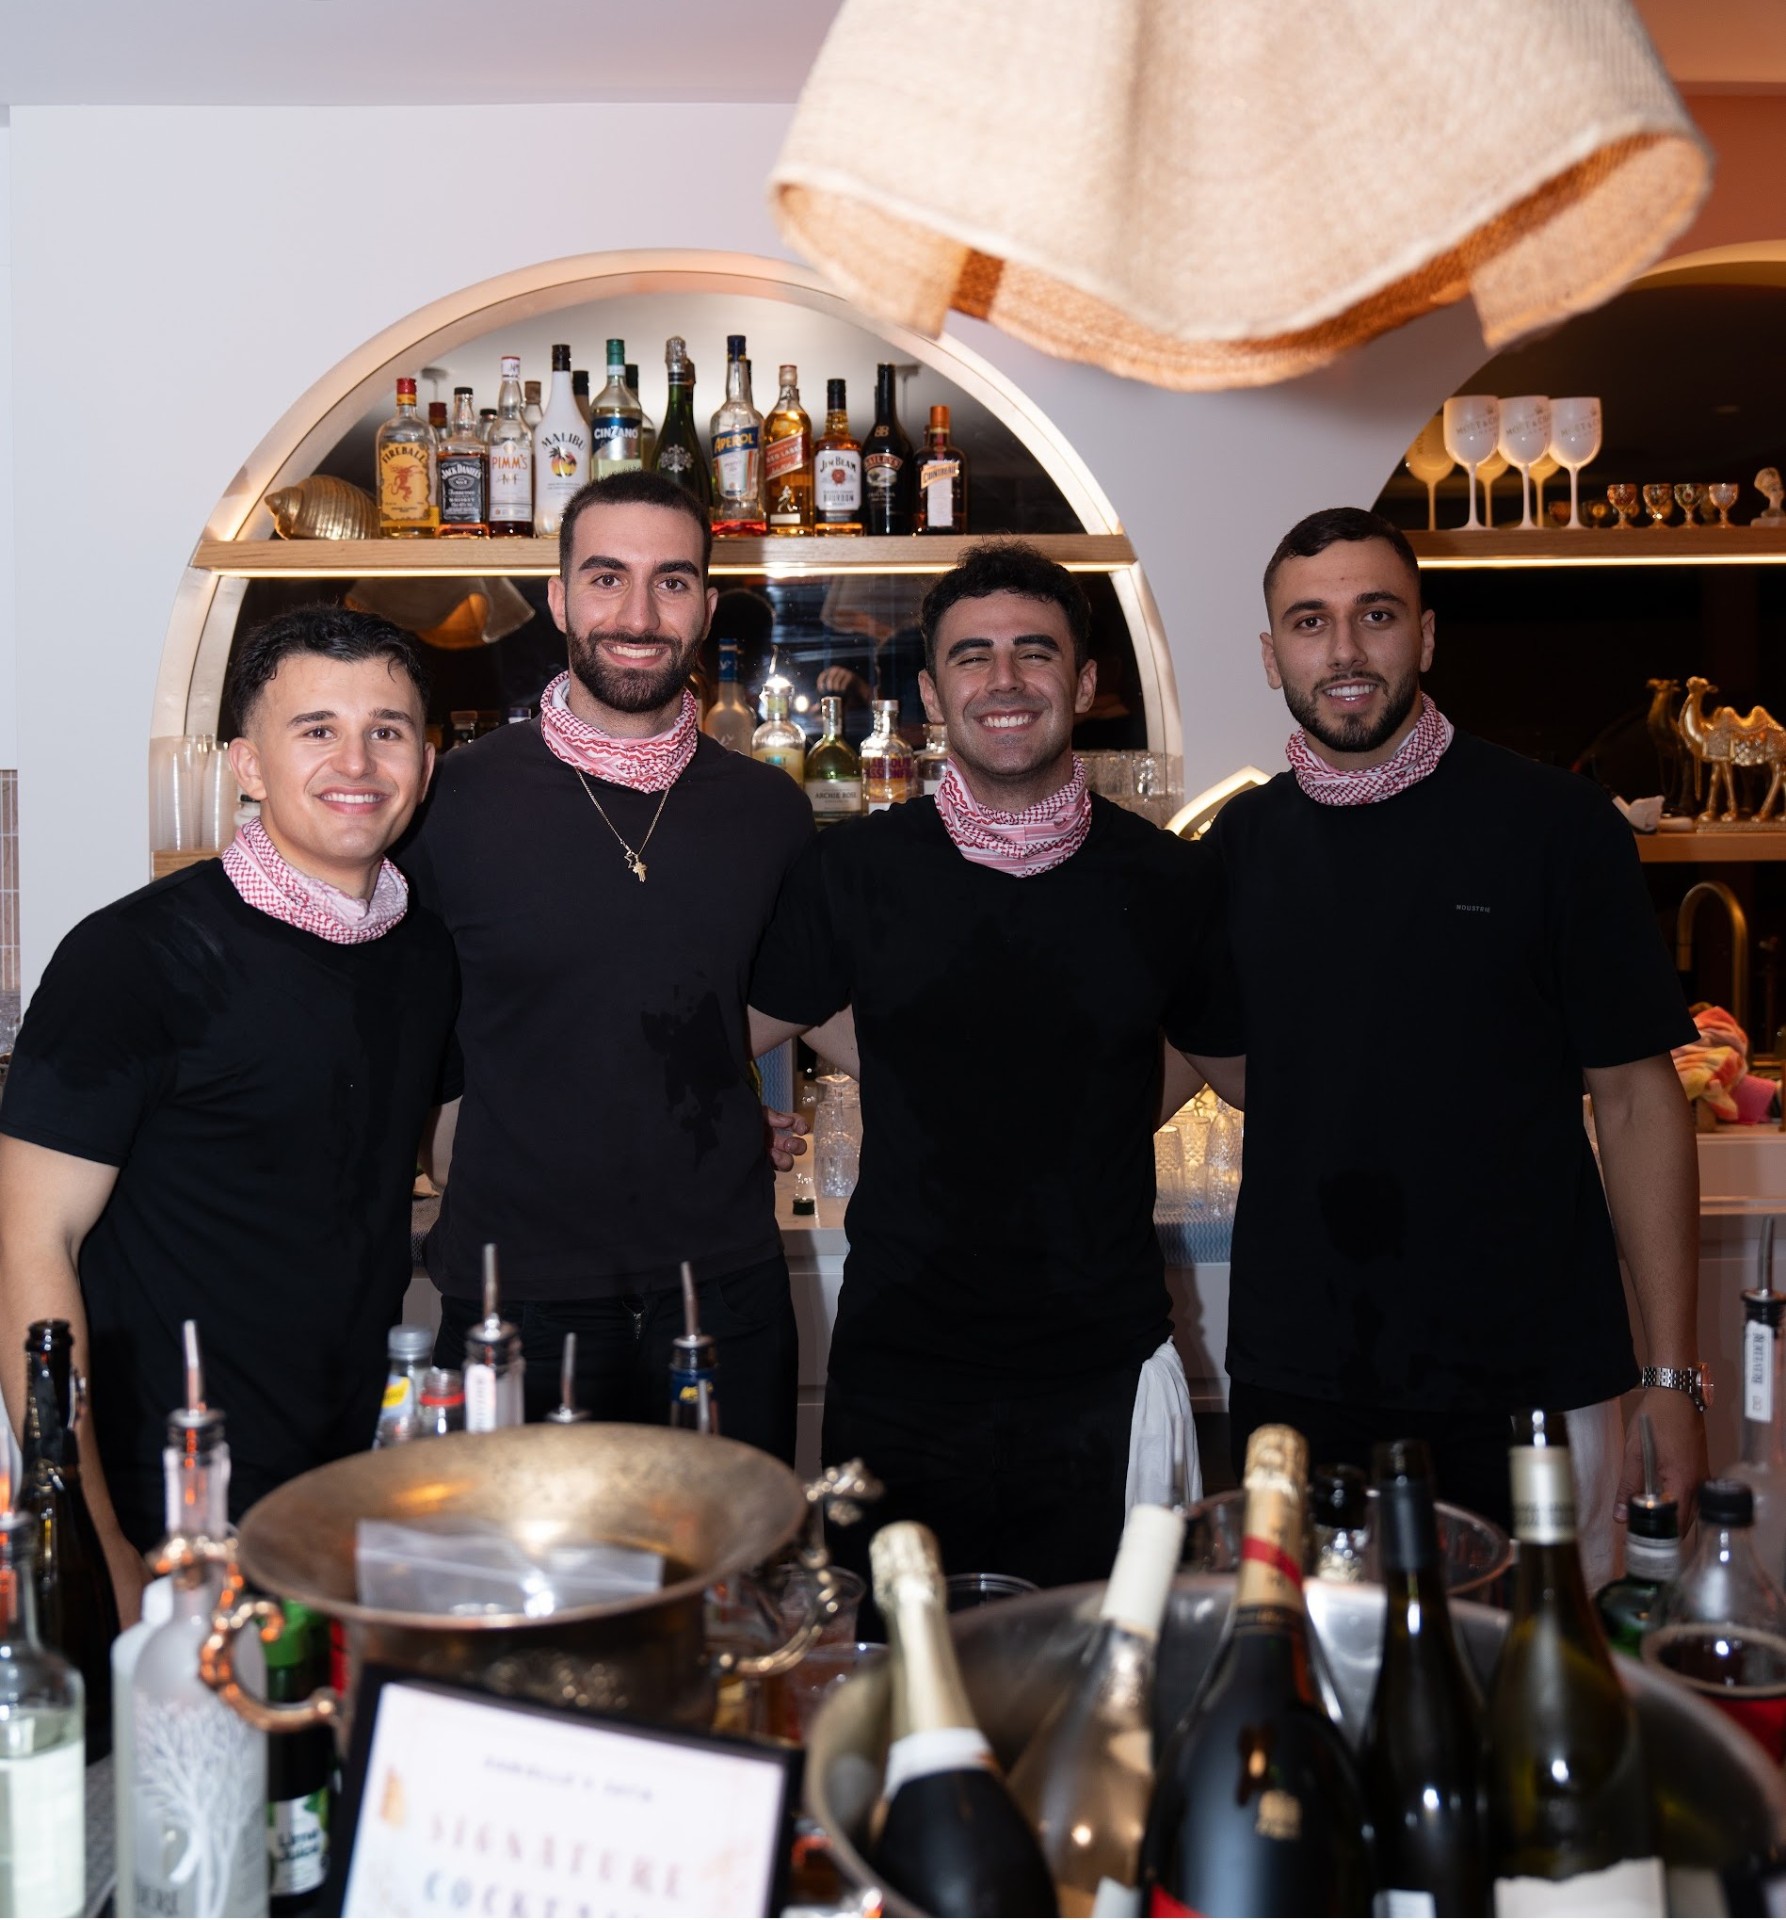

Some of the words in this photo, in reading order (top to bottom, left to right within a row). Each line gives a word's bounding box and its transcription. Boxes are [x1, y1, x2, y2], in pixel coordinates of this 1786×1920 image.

[594, 425, 639, 439] CINZANO
[541, 432, 586, 451] MALIBU
[714, 433, 754, 453] APEROL
[382, 446, 426, 464] FIREBALL
[492, 454, 528, 470] PIMM'S
[766, 453, 780, 463] RED
[865, 455, 901, 468] BAILEYS
[820, 459, 834, 472] JIM
[835, 456, 857, 472] BEAM
[441, 467, 457, 480] JACK
[922, 464, 956, 484] COINTREAU
[429, 1811, 683, 1900] SIGNATURE
